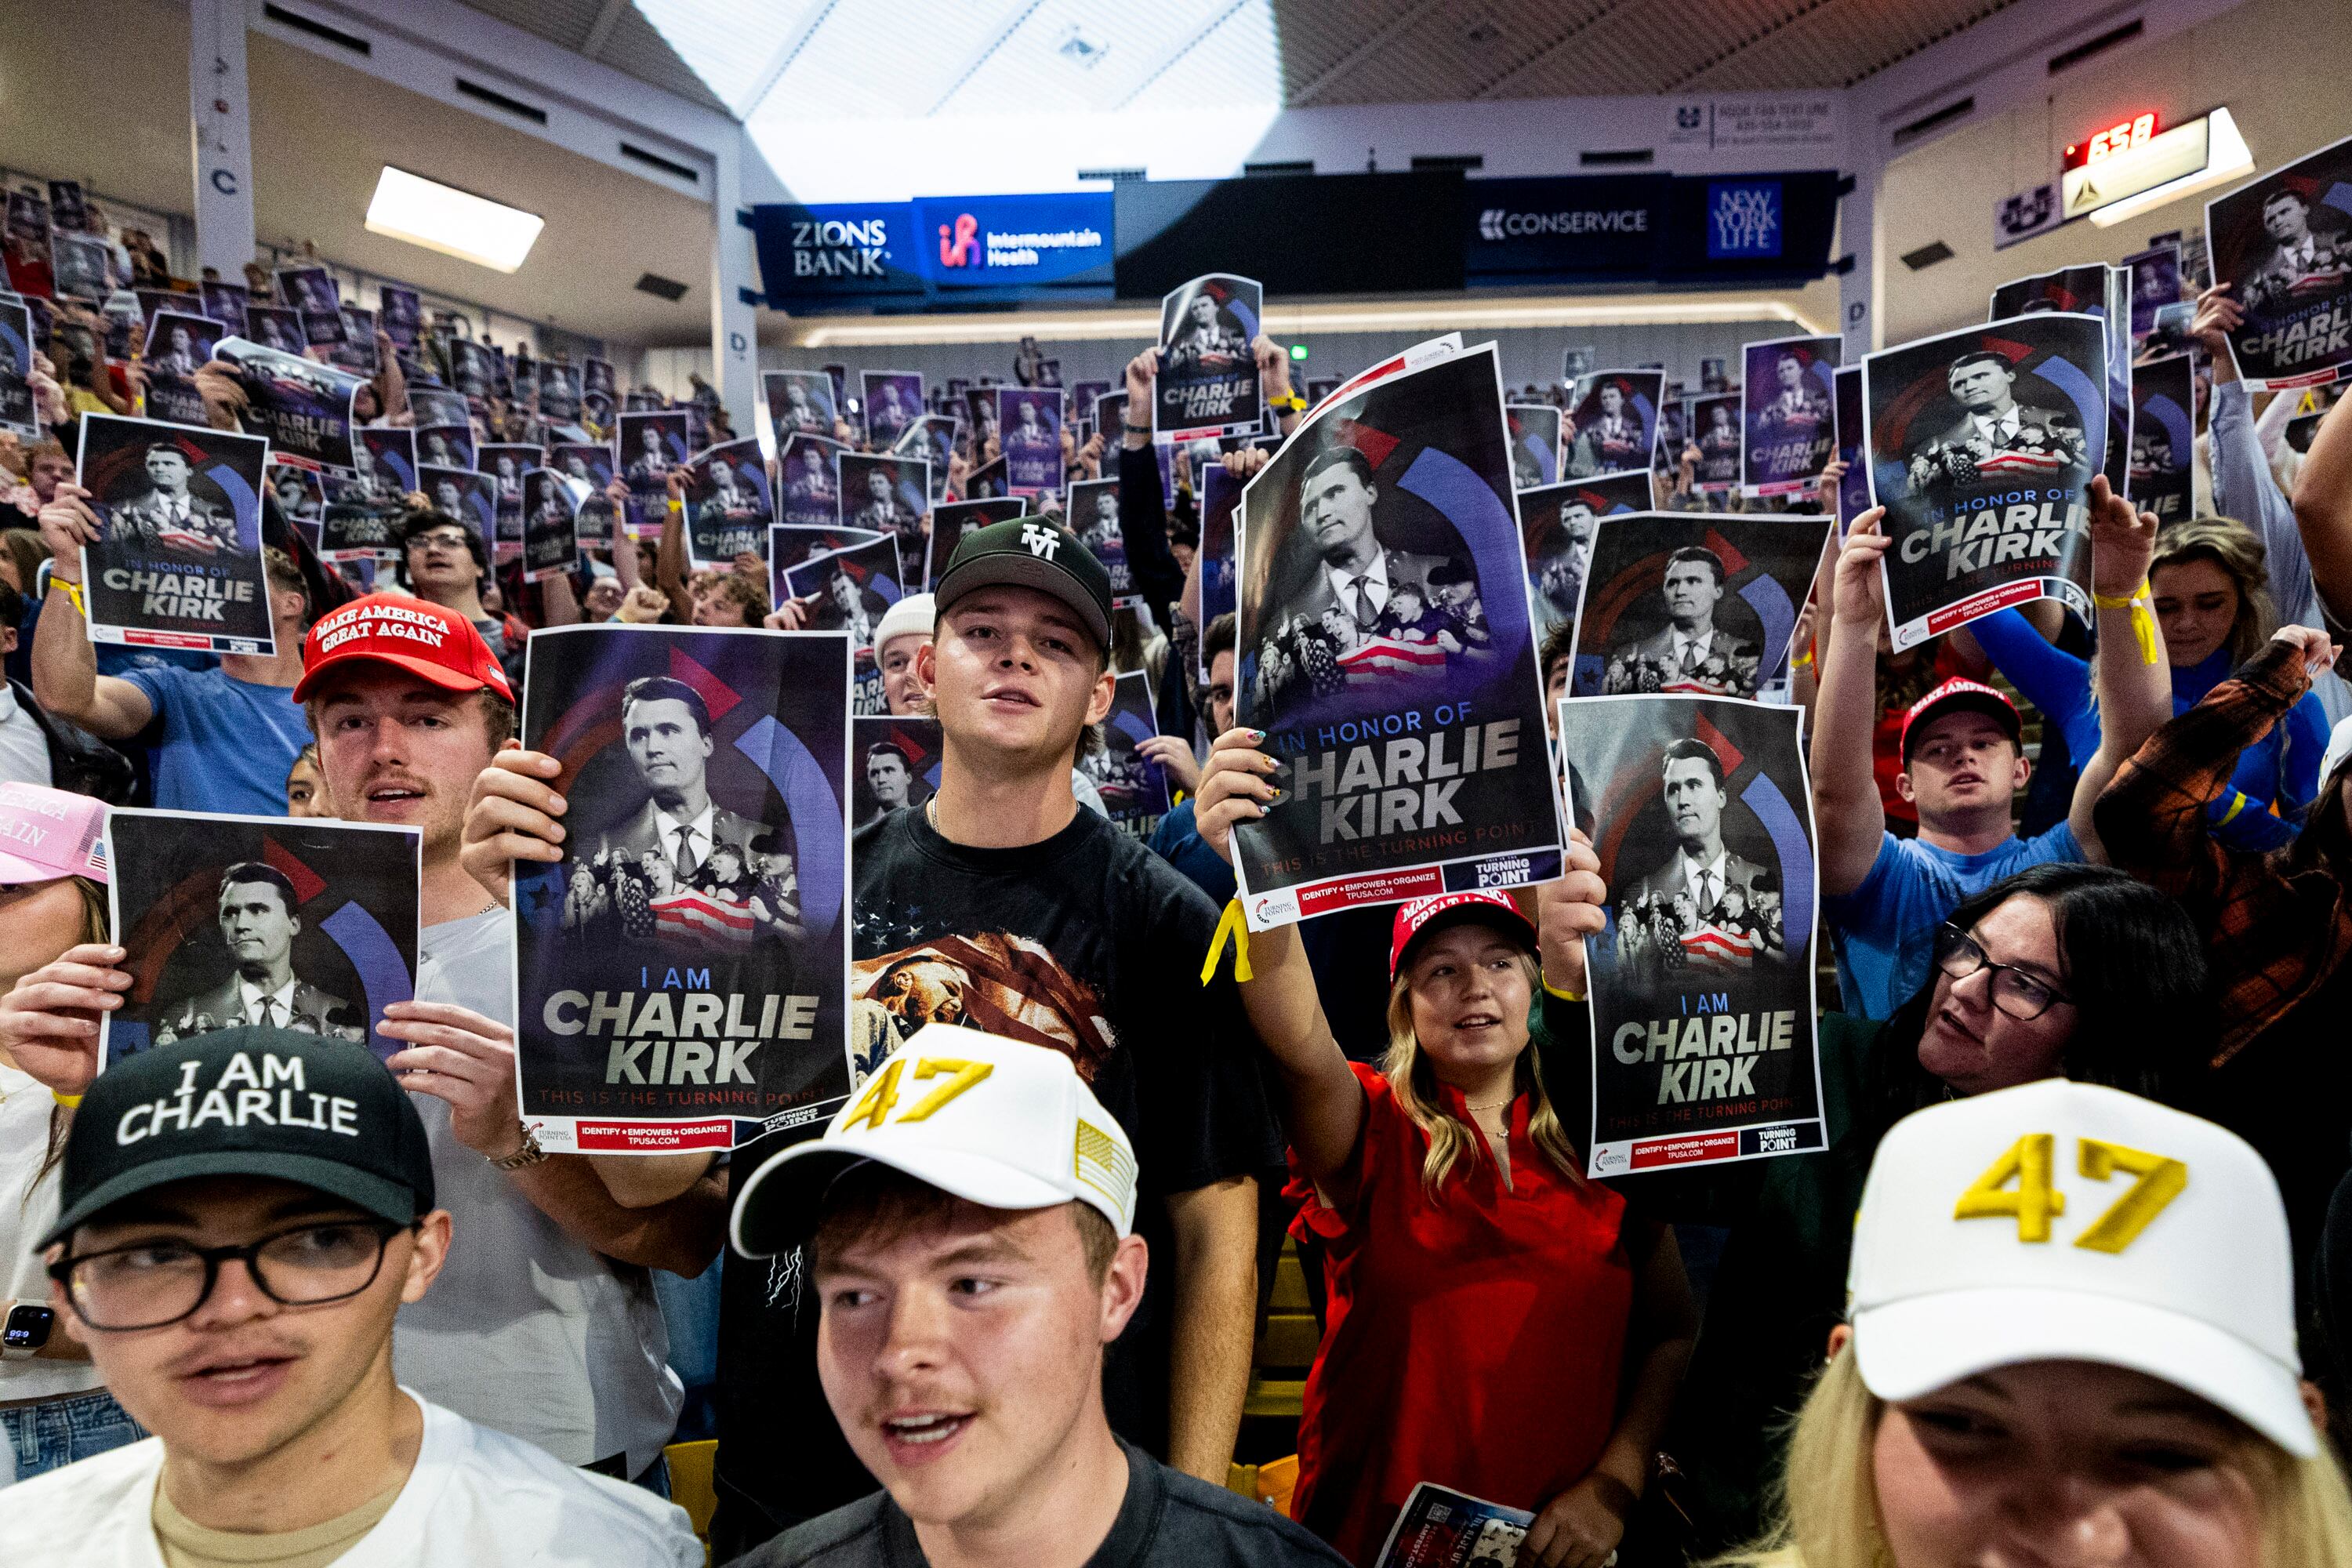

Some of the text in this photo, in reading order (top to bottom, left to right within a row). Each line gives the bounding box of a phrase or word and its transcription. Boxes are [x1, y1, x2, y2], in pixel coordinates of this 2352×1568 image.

[211, 169, 237, 194] C
[1721, 191, 1772, 212] NEW
[1506, 209, 1647, 235] CONSERVICE
[1713, 207, 1777, 232] YORK
[791, 219, 887, 247] ZIONS
[987, 228, 1102, 249] Intermountain
[1721, 229, 1770, 250] LIFE
[794, 248, 885, 278] BANK
[988, 249, 1040, 267] Health
[2241, 307, 2352, 354] CHARL
[2274, 326, 2350, 368] KIRK
[1163, 379, 1253, 405] CHARLIE
[1184, 397, 1232, 419] KIRK
[1955, 489, 2036, 514] HONOR
[2047, 488, 2077, 501] OF
[1946, 529, 2067, 581] KIRK
[148, 561, 205, 576] HONOR
[209, 566, 231, 578] OF
[103, 568, 255, 603] CHARLIE
[142, 593, 226, 621] KIRK
[1962, 594, 1996, 612] EMPOWER
[315, 604, 450, 641] MAKE AMERICA
[321, 621, 444, 653] GREAT AGAIN
[854, 691, 887, 715] IRK
[1911, 686, 1945, 717] MAKE
[1279, 701, 1472, 754] IN HONOR OF
[1268, 718, 1521, 807] CHARLIE
[1320, 778, 1466, 845] KIRK
[1261, 857, 1301, 877] THIS
[1378, 829, 1467, 856] TURNING
[1475, 858, 1530, 873] TURNING
[1301, 872, 1436, 902] IDENTIFY EMPOWER ORGANIZE
[1479, 868, 1530, 887] POINT
[1346, 887, 1394, 900] TPUSA.COM
[1265, 902, 1292, 913] TURNING
[641, 966, 711, 989] I AM
[543, 989, 820, 1040] CHARLIE
[1681, 993, 1729, 1015] I AM
[1613, 1010, 1796, 1065] CHARLIE
[174, 1052, 306, 1097] I AM
[604, 1040, 761, 1085] KIRK
[1657, 1055, 1760, 1105] KIRK
[539, 1090, 584, 1105] THIS
[592, 1091, 609, 1105] IS
[618, 1091, 658, 1105] THE
[666, 1091, 760, 1106] TURNING
[841, 1056, 994, 1133] 47
[116, 1088, 359, 1146] CHARLIE
[762, 1108, 818, 1127] TURNING
[1698, 1100, 1757, 1120] TURNING
[1761, 1097, 1794, 1112] POIN
[582, 1125, 728, 1137] IDENTIFY EMPOWER ORGANIZE
[765, 1112, 818, 1132] POINT
[1759, 1128, 1796, 1140] TURNING
[628, 1137, 680, 1145] TPUSA.COM
[1635, 1137, 1735, 1155] IDENTIFY EMPOWER ORGANIZE
[1760, 1137, 1797, 1152] POINT
[1668, 1149, 1704, 1160] TPUSA.COM
[1953, 1133, 2189, 1256] 47
[1405, 1523, 1431, 1568] AMFEST.CO
[1417, 1525, 1439, 1563] REGISTER
